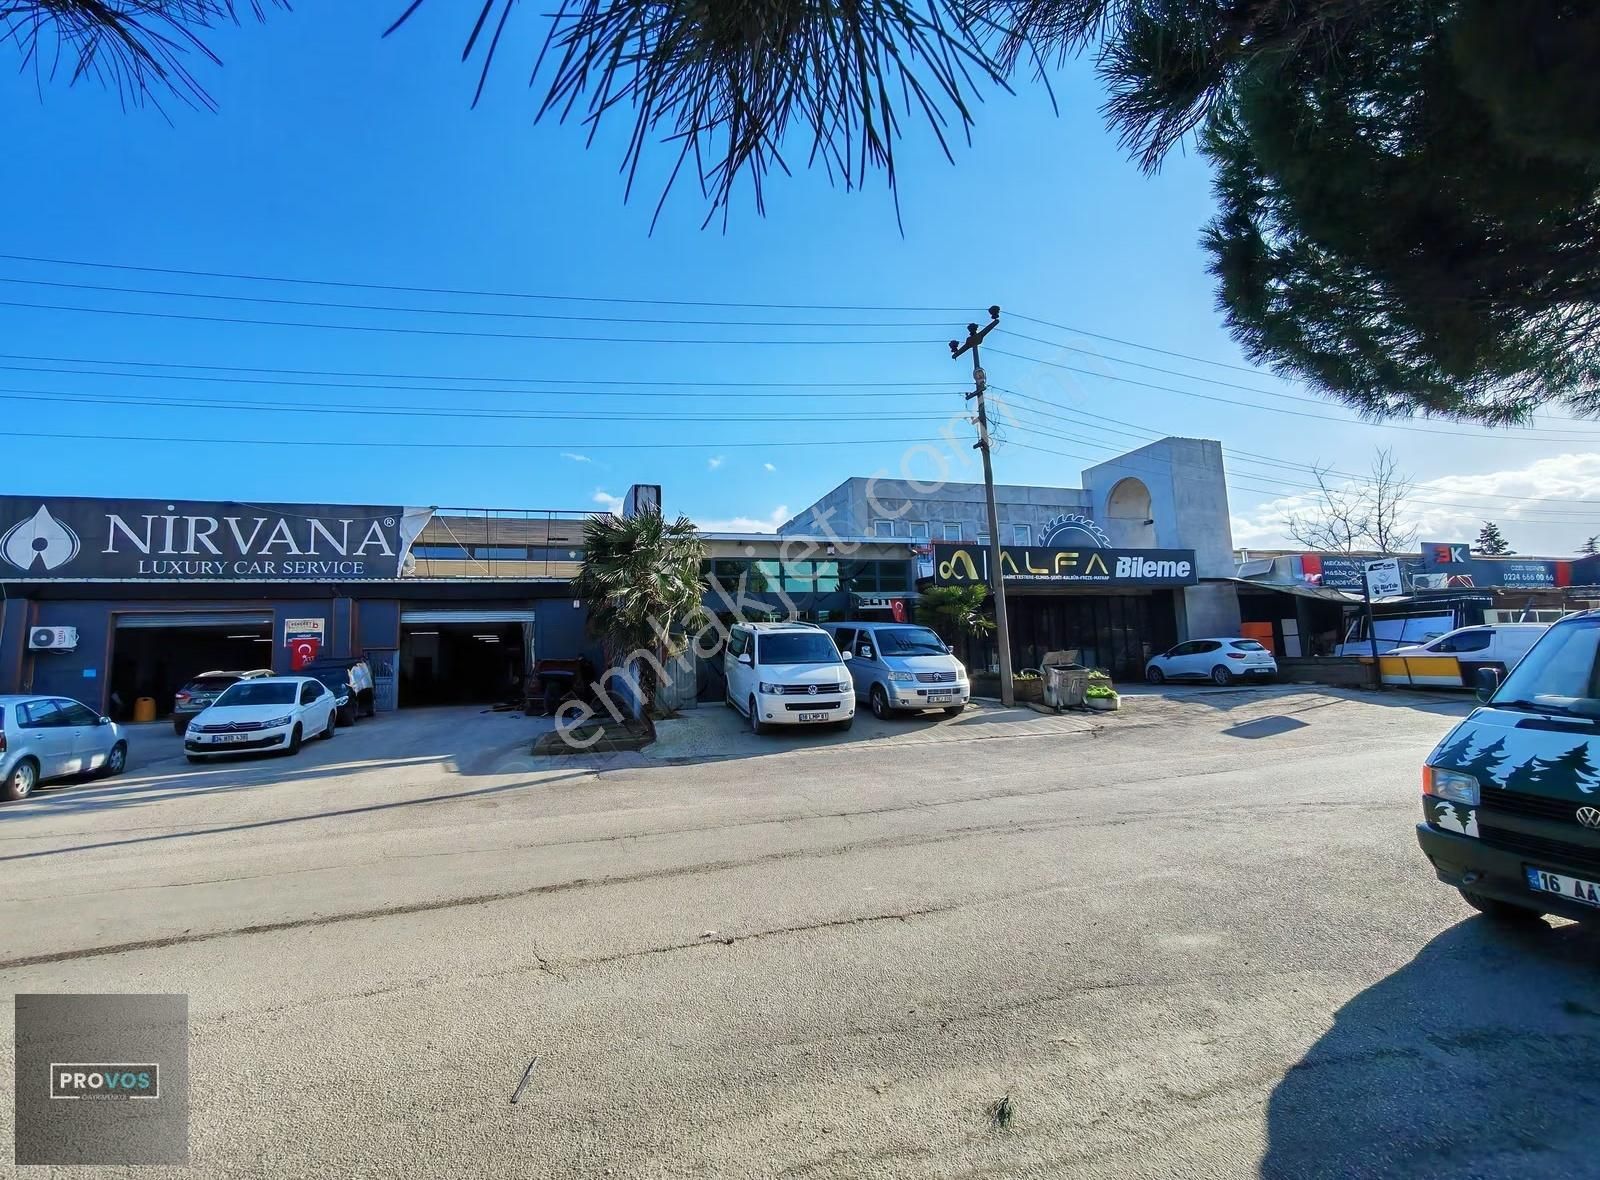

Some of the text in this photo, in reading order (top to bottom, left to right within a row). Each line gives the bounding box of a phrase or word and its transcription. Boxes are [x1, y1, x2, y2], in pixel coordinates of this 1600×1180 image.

[138, 560, 365, 575] LUXURY CAR SERVICE
[1115, 556, 1192, 578] Bileme
[1541, 873, 1561, 892] 16
[1574, 881, 1600, 902] AA
